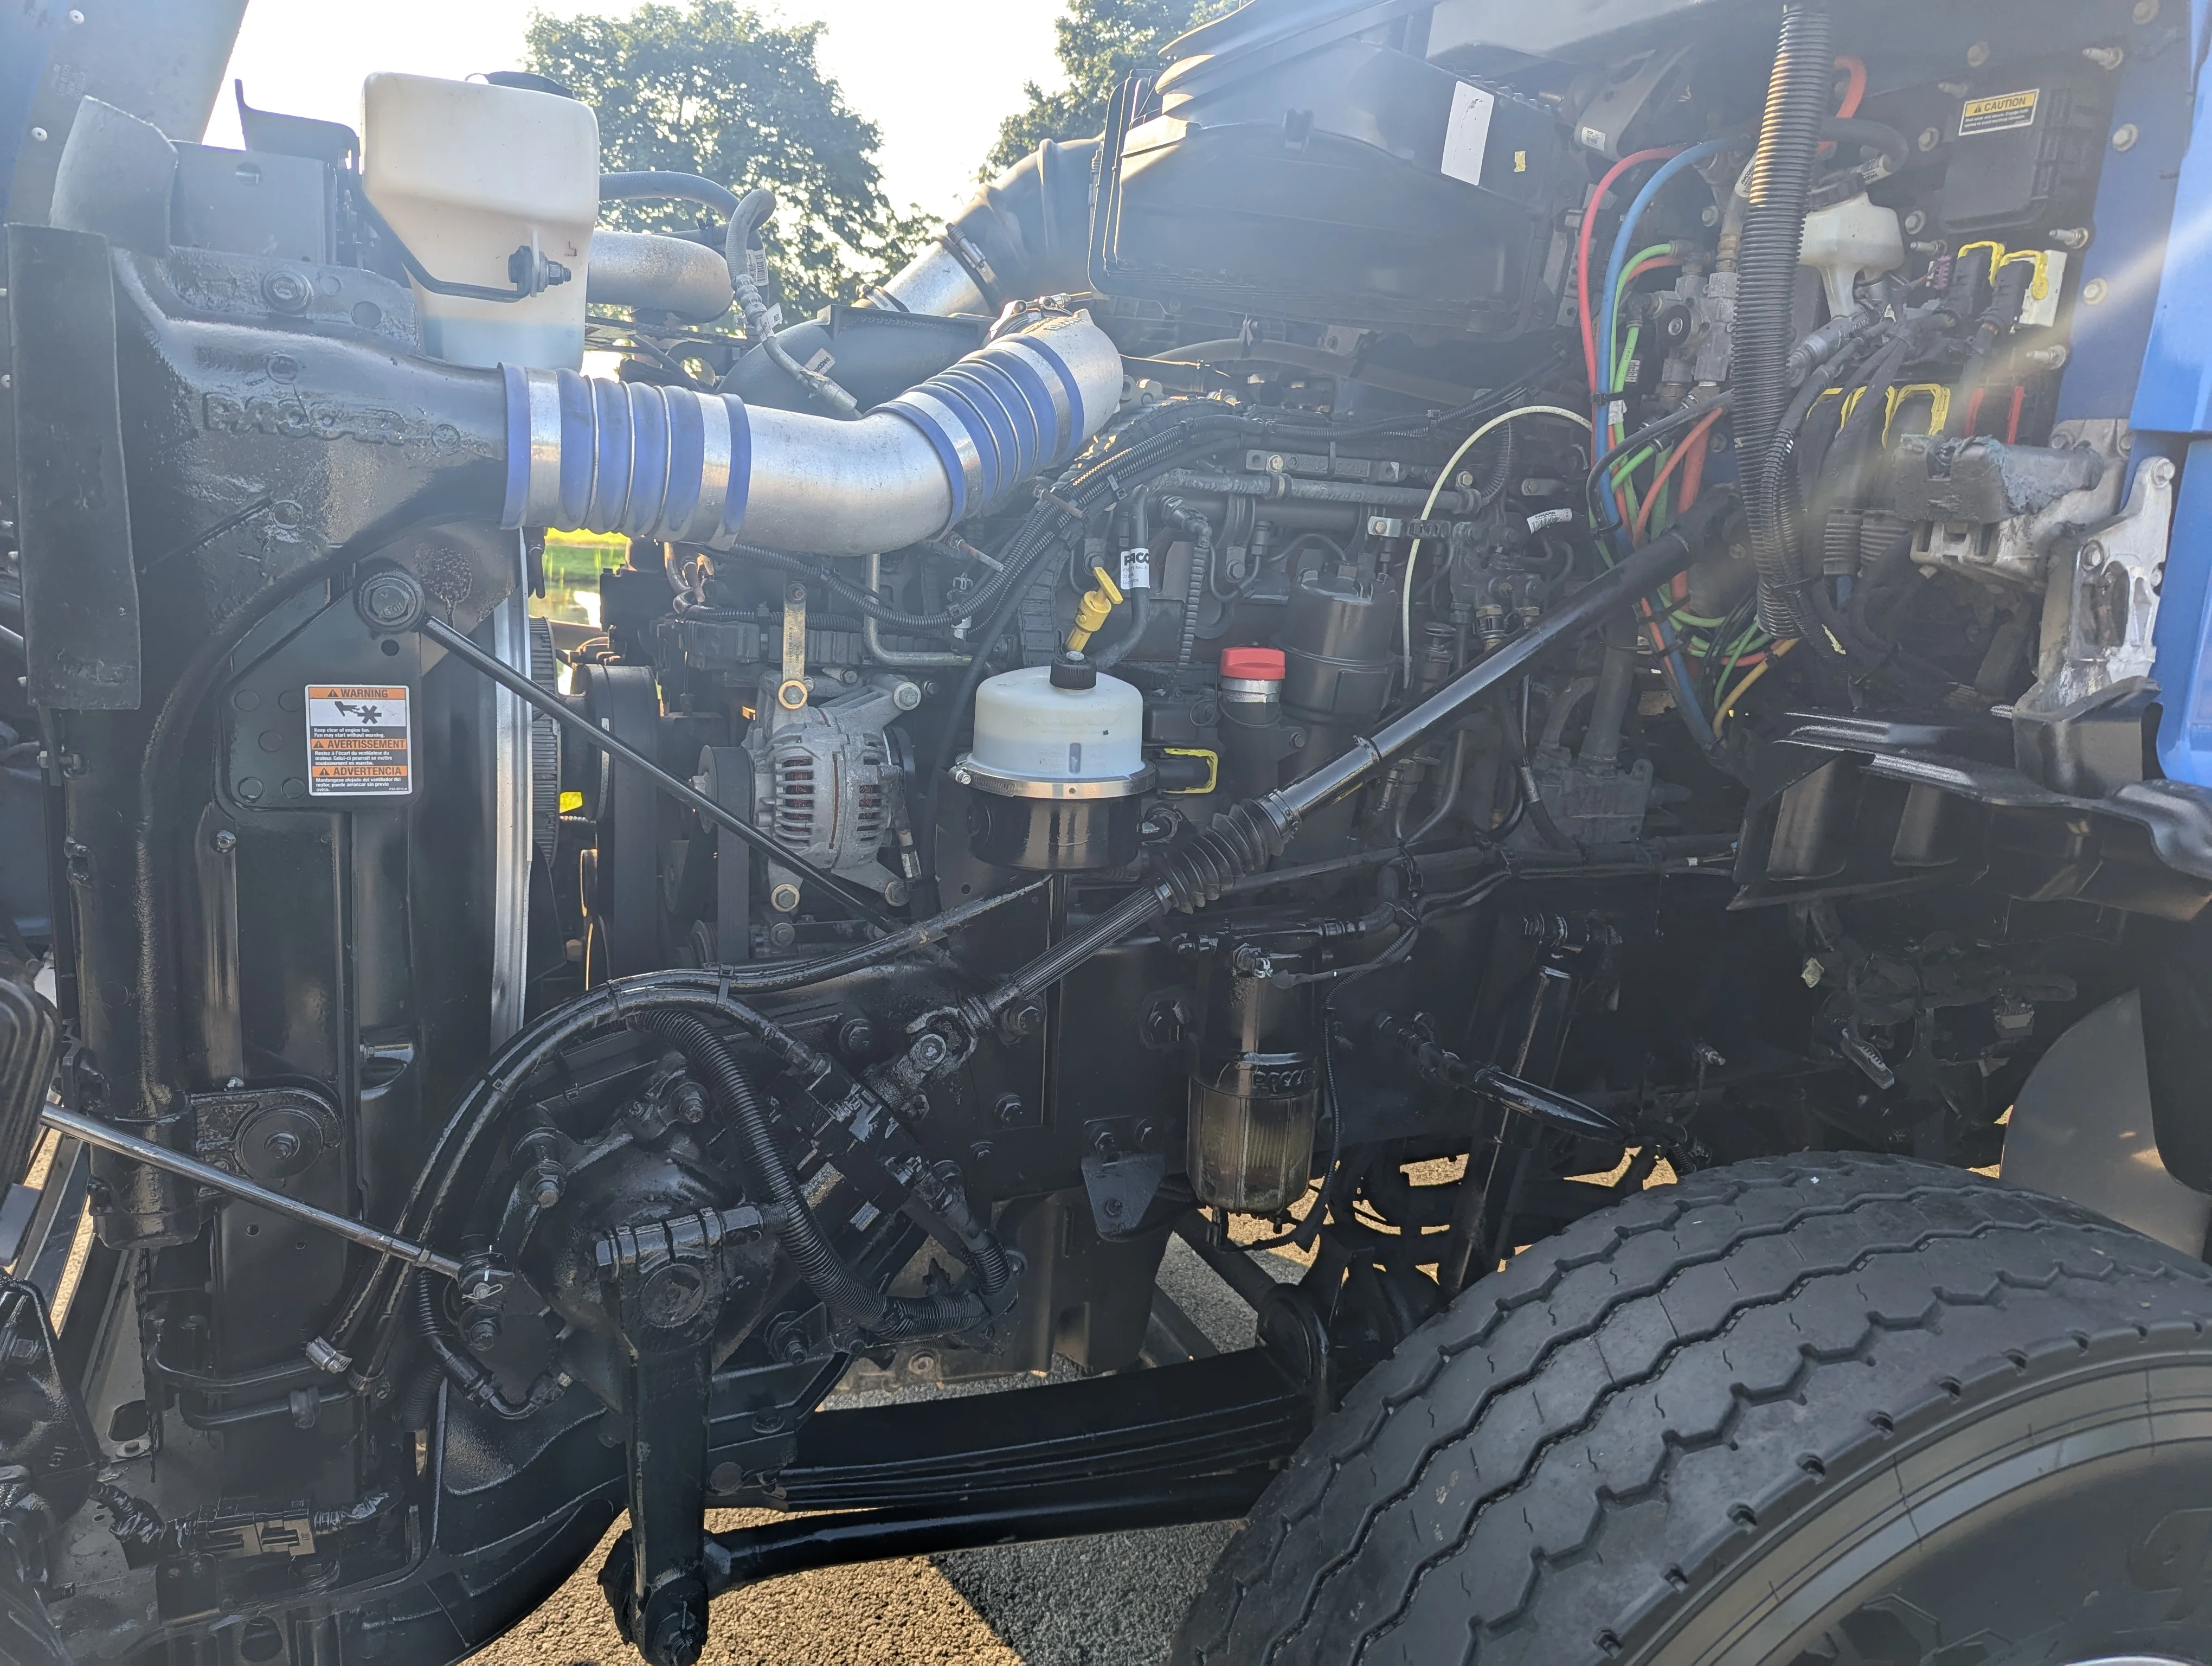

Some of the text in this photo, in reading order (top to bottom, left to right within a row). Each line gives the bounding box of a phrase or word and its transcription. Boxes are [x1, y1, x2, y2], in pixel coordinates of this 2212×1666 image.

[1984, 97, 2026, 112] CAUTION
[340, 689, 388, 698] WARNING
[327, 740, 405, 748] AVERTISSEMENT
[1039, 757, 1064, 765] COLD
[333, 766, 402, 776] ADVERTENCIA
